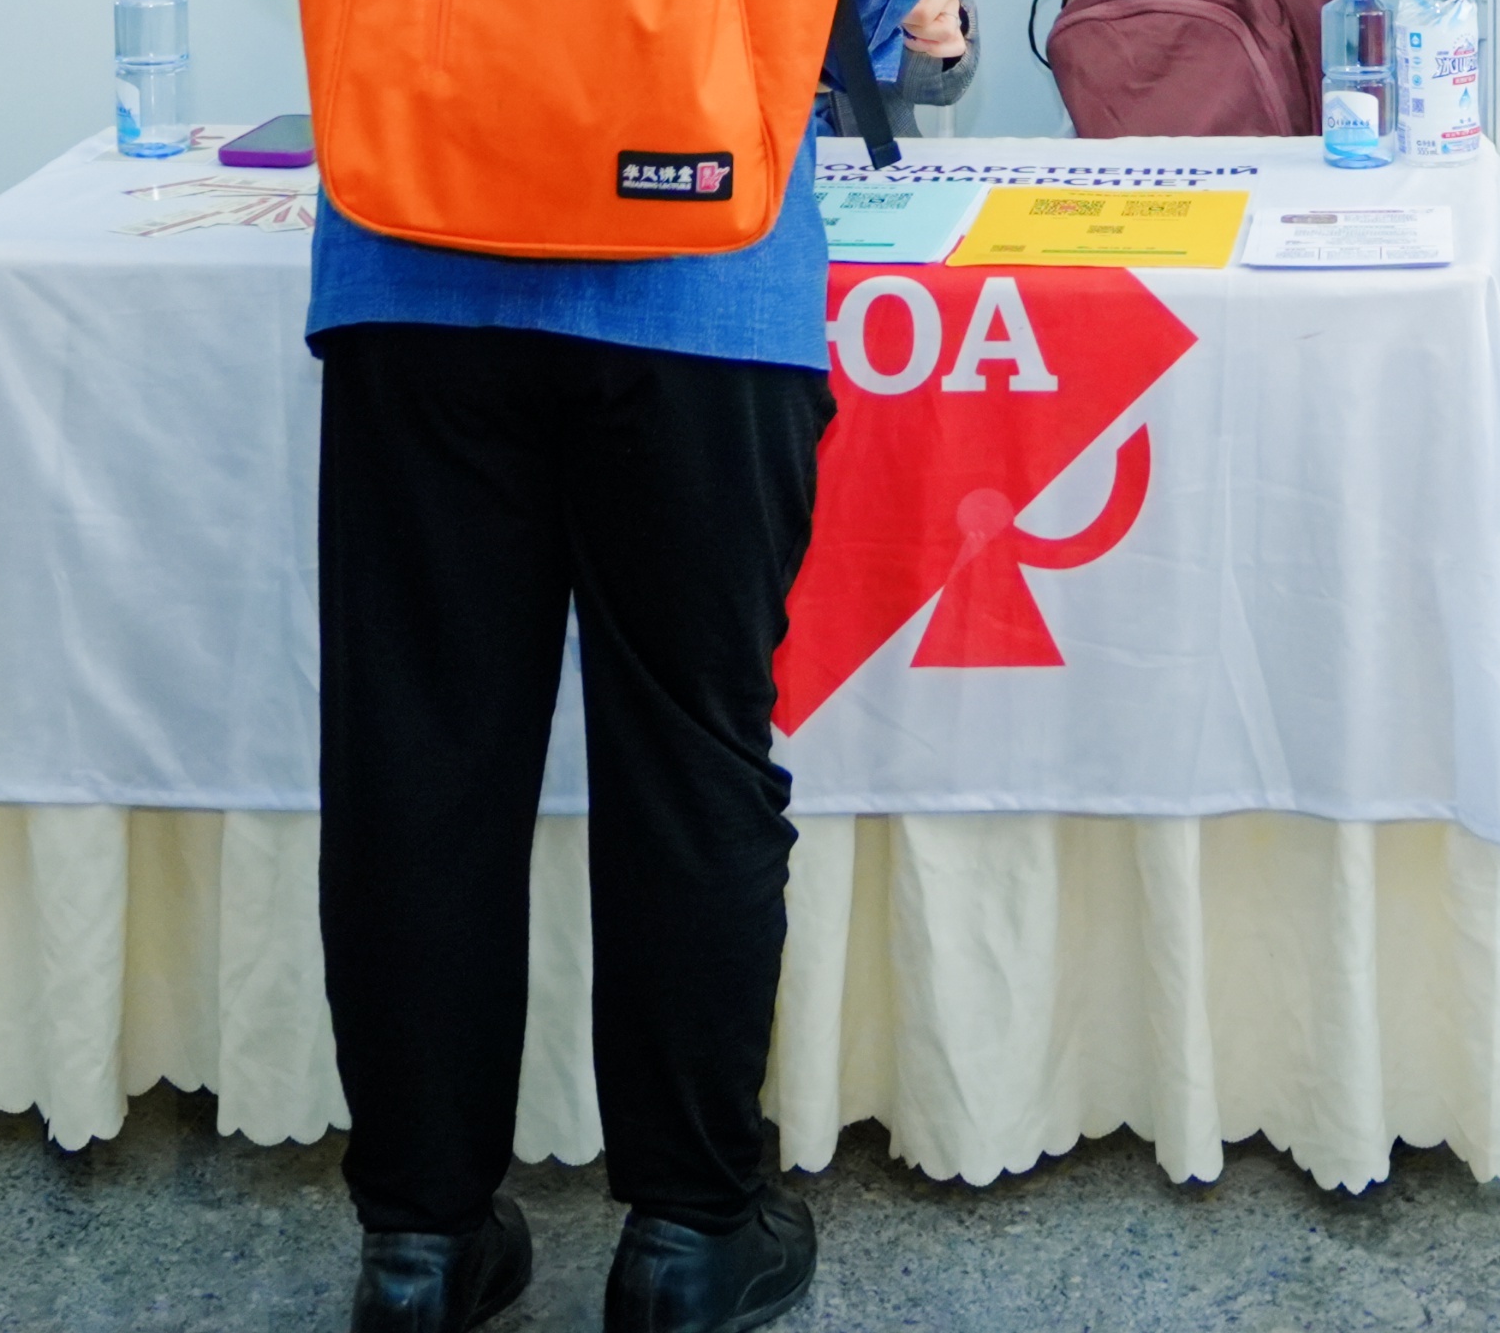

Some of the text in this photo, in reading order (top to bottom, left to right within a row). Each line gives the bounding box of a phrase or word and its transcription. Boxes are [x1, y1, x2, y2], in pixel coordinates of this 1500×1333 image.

[816, 162, 1258, 176] ОСУДАРСТВЕННЫЙ
[885, 176, 1207, 188] УНИВЕРСИТЕТ
[826, 275, 1058, 395] ЮА
